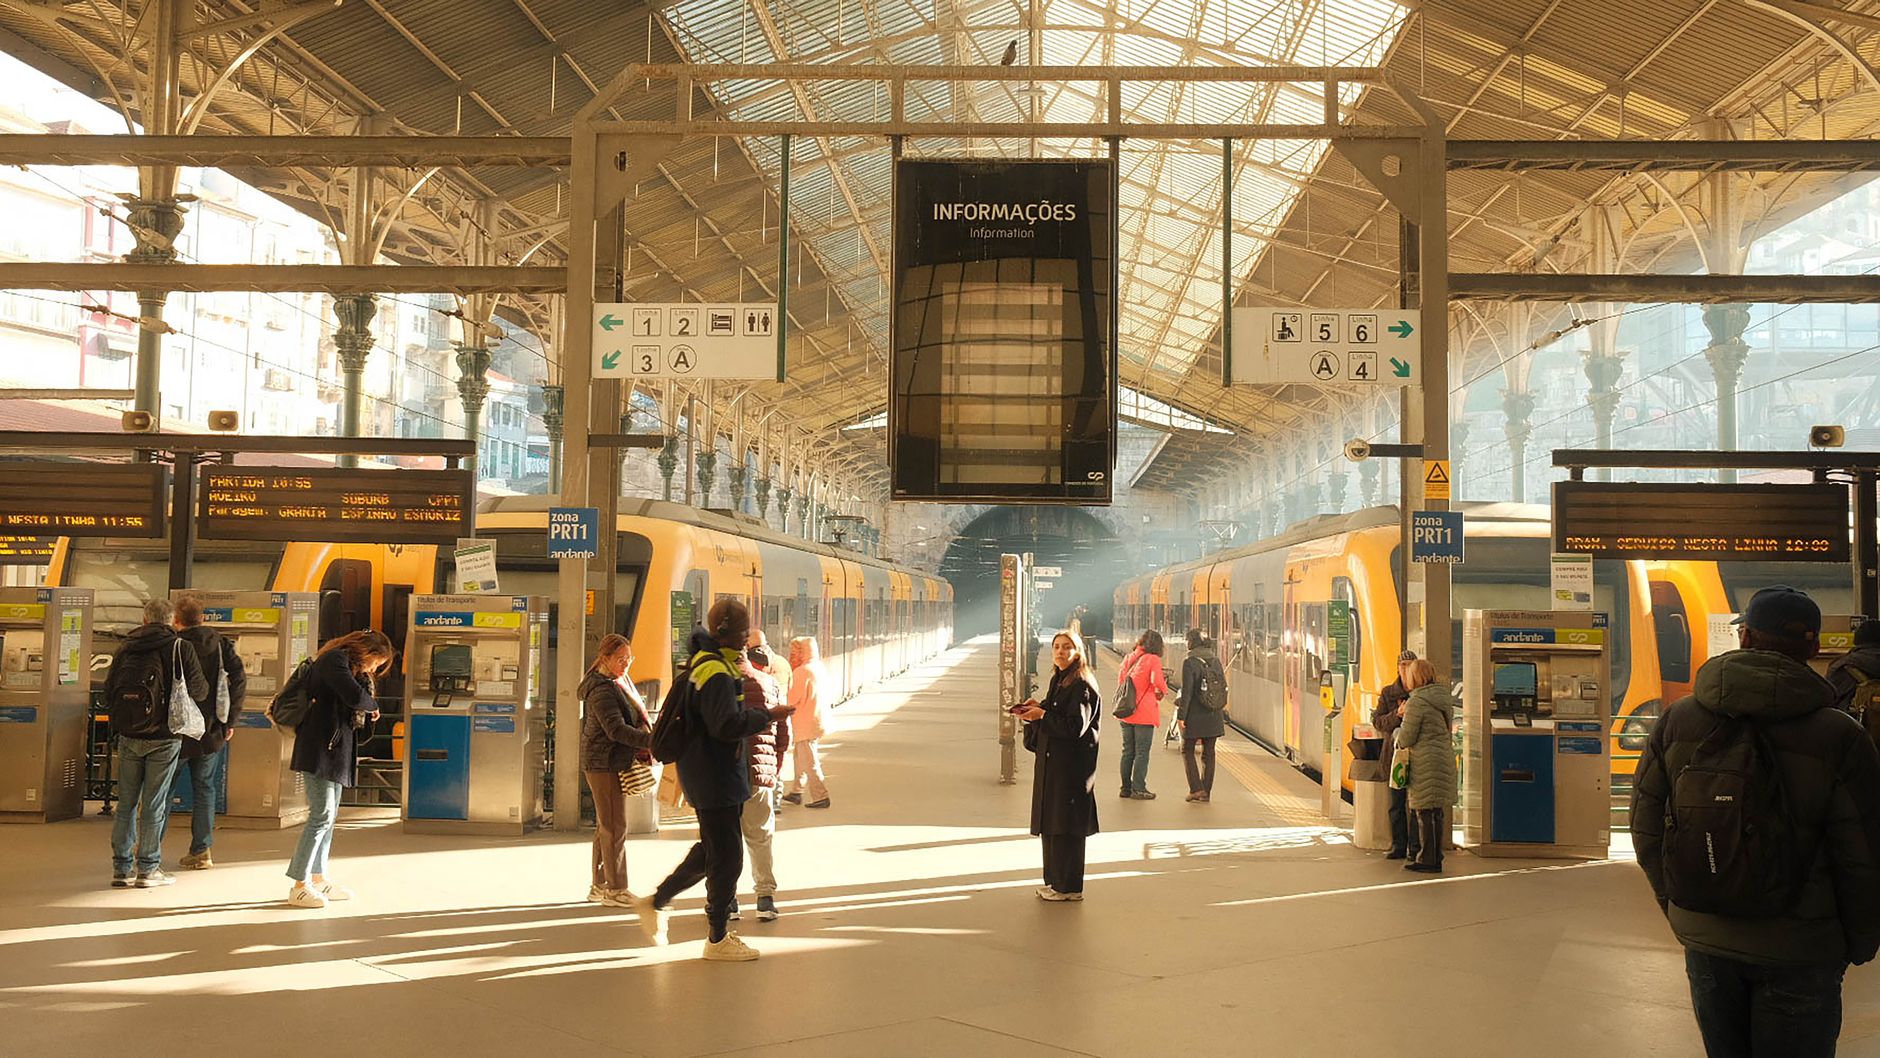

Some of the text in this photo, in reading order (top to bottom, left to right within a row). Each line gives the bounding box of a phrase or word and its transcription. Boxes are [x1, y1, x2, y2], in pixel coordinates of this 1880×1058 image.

[933, 200, 1076, 225] INFORMAÇÕES
[970, 227, 1034, 239] Information
[642, 317, 690, 336] 1 2
[1319, 323, 1368, 342] 5 6
[641, 350, 690, 372] 3 A
[1316, 357, 1368, 379] A 4
[551, 513, 579, 522] zona
[1414, 517, 1443, 526] zona
[551, 523, 587, 540] PRT1
[1414, 527, 1452, 544] PRT1
[551, 548, 595, 559] andante
[1415, 552, 1461, 563] andante
[424, 615, 463, 625] andante
[1502, 632, 1545, 643] andante
